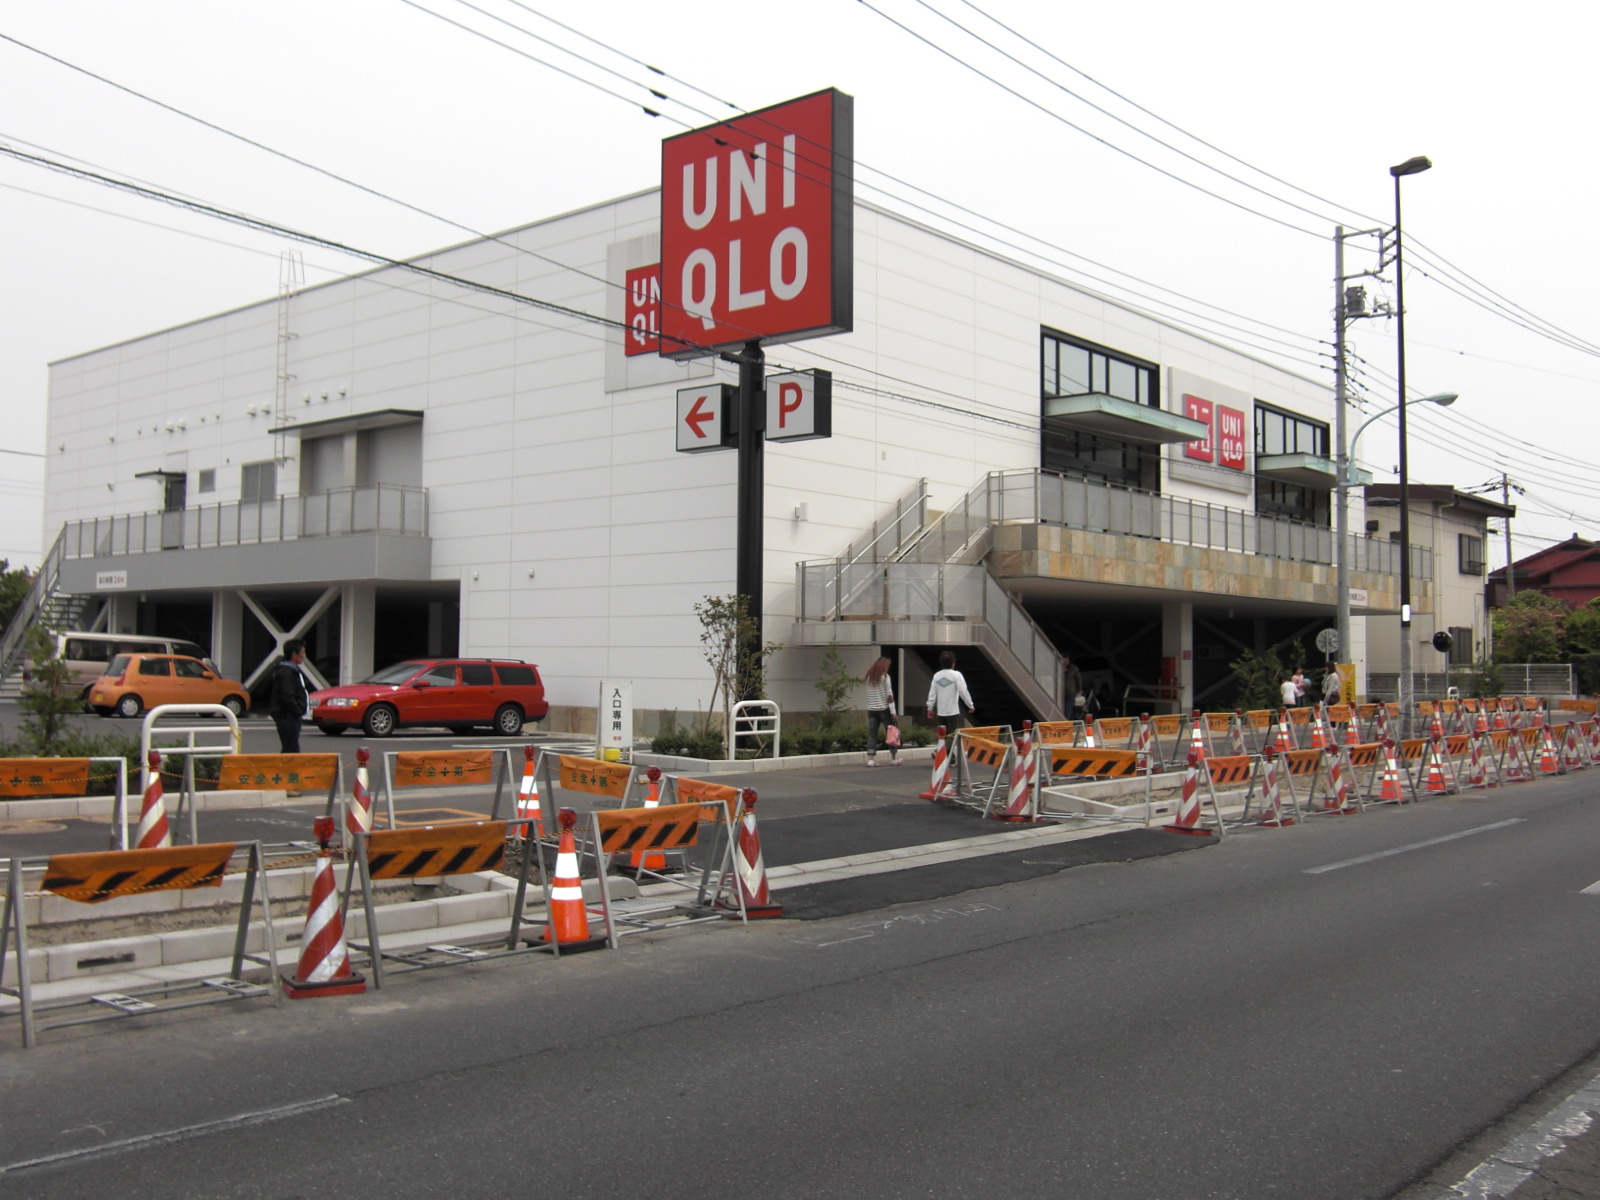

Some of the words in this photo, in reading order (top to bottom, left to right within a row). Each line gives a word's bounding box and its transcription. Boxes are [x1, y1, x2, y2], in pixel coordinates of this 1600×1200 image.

[682, 133, 796, 231] UNI
[633, 275, 660, 308] UN
[681, 226, 808, 331] QLO
[632, 310, 660, 346] QL
[779, 381, 803, 429] P
[1222, 413, 1241, 438] UNI
[1222, 438, 1243, 462] QLO
[612, 688, 622, 731] 入口専用
